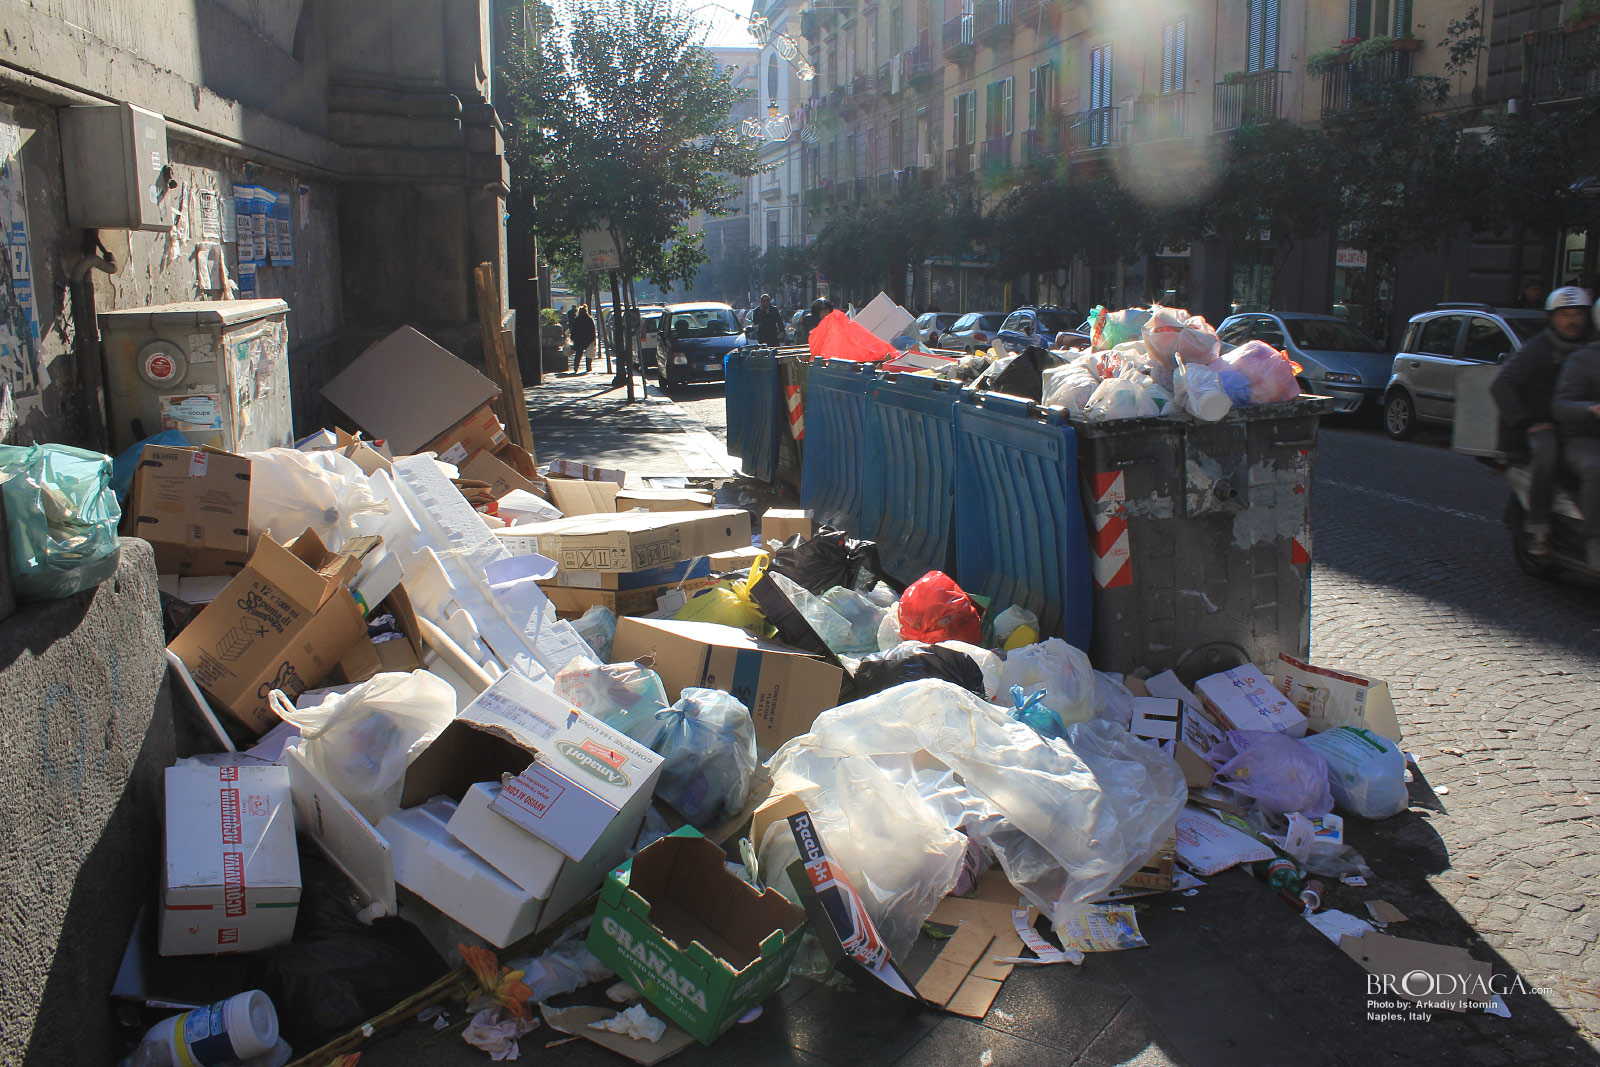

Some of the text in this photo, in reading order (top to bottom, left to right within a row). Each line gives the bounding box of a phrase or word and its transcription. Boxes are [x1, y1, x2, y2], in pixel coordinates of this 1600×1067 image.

[760, 694, 765, 702] DA
[763, 693, 771, 720] FLACONI
[769, 685, 780, 716] CONTIENE
[566, 745, 620, 783] Amadori
[613, 737, 652, 765] CONTIENE
[223, 790, 241, 843] ACQUAVIVA
[524, 796, 546, 812] AVVISO
[795, 813, 829, 882] Reebok
[224, 853, 244, 916] ACQUAVIVA
[601, 916, 707, 1012] GRANATA
[646, 939, 673, 962] ANTONIO
[847, 940, 885, 968] Reebok
[617, 947, 684, 1003] OLIVETO IN TAVOLA
